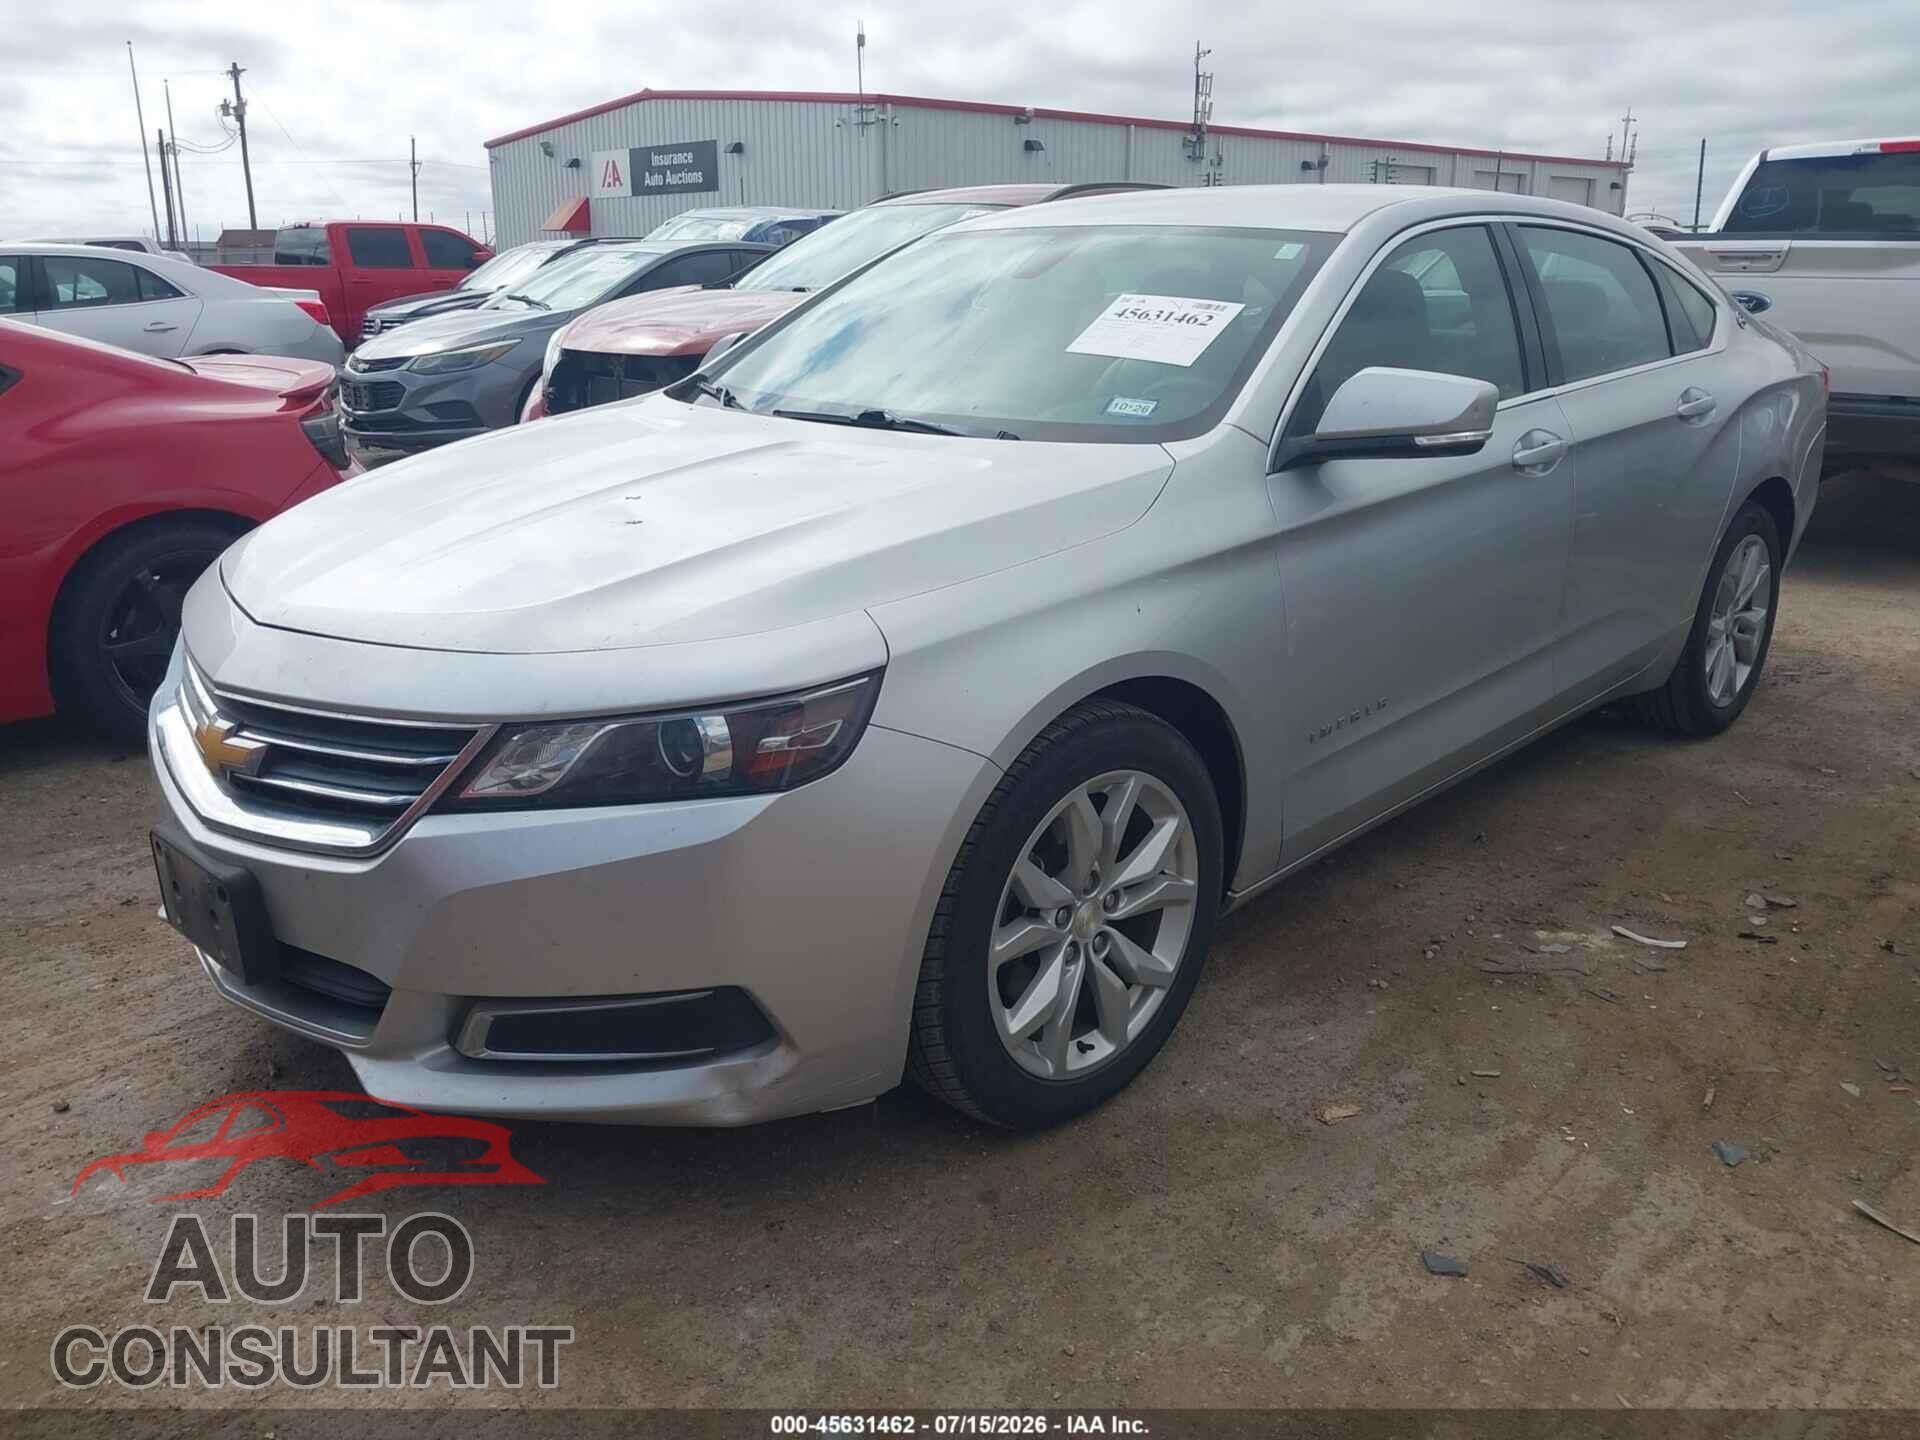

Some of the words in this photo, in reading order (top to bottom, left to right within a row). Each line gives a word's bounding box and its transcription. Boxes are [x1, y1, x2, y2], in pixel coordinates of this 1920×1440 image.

[651, 152, 693, 166] Insurance
[644, 171, 664, 187] Auto
[665, 169, 704, 185] Auctions
[1113, 307, 1215, 327] 45631462
